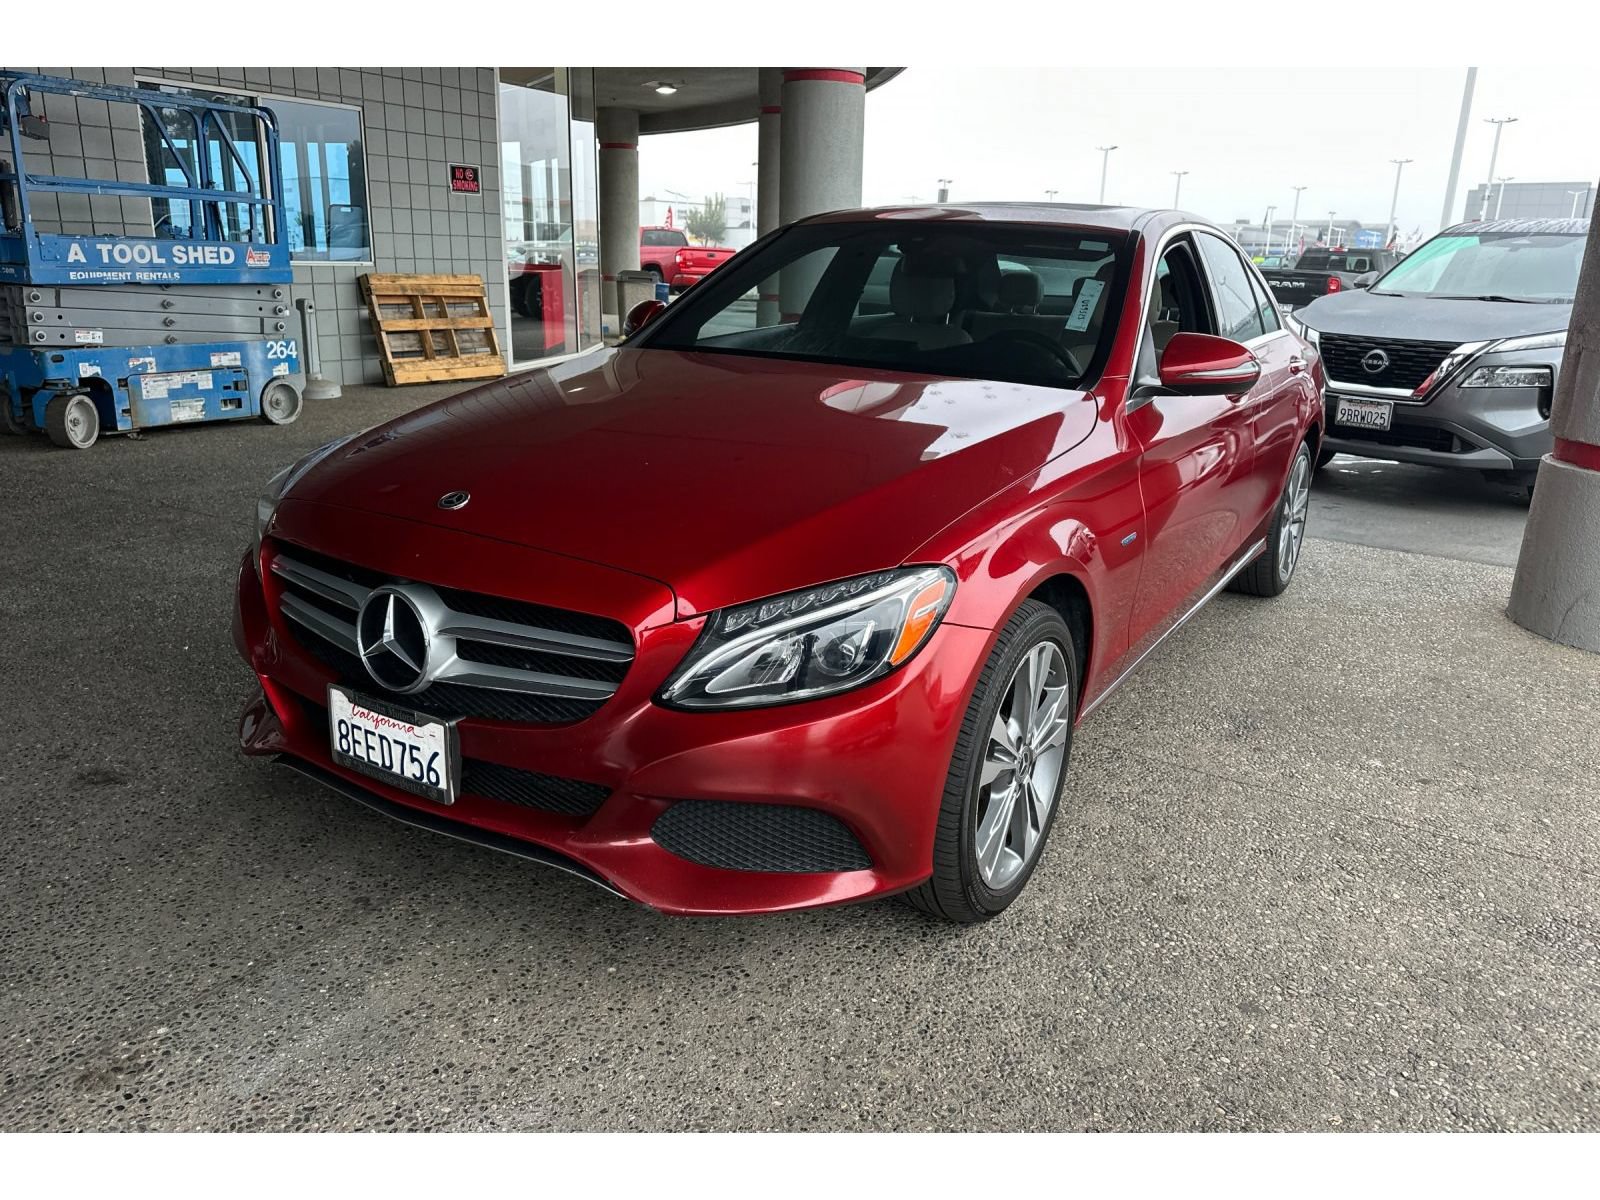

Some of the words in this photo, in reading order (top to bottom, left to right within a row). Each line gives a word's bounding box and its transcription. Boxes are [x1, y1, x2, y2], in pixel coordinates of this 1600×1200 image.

[455, 168, 464, 179] NO
[453, 180, 479, 191] SMOKING
[67, 242, 88, 263] A
[96, 243, 166, 264] TOOL
[172, 245, 235, 265] SHED
[136, 272, 181, 281] RENTALS
[1268, 280, 1305, 288] RAM
[266, 340, 298, 359] 264
[1340, 407, 1386, 426] 9BRW025
[351, 703, 424, 739] California
[337, 719, 440, 788] 8EED756
